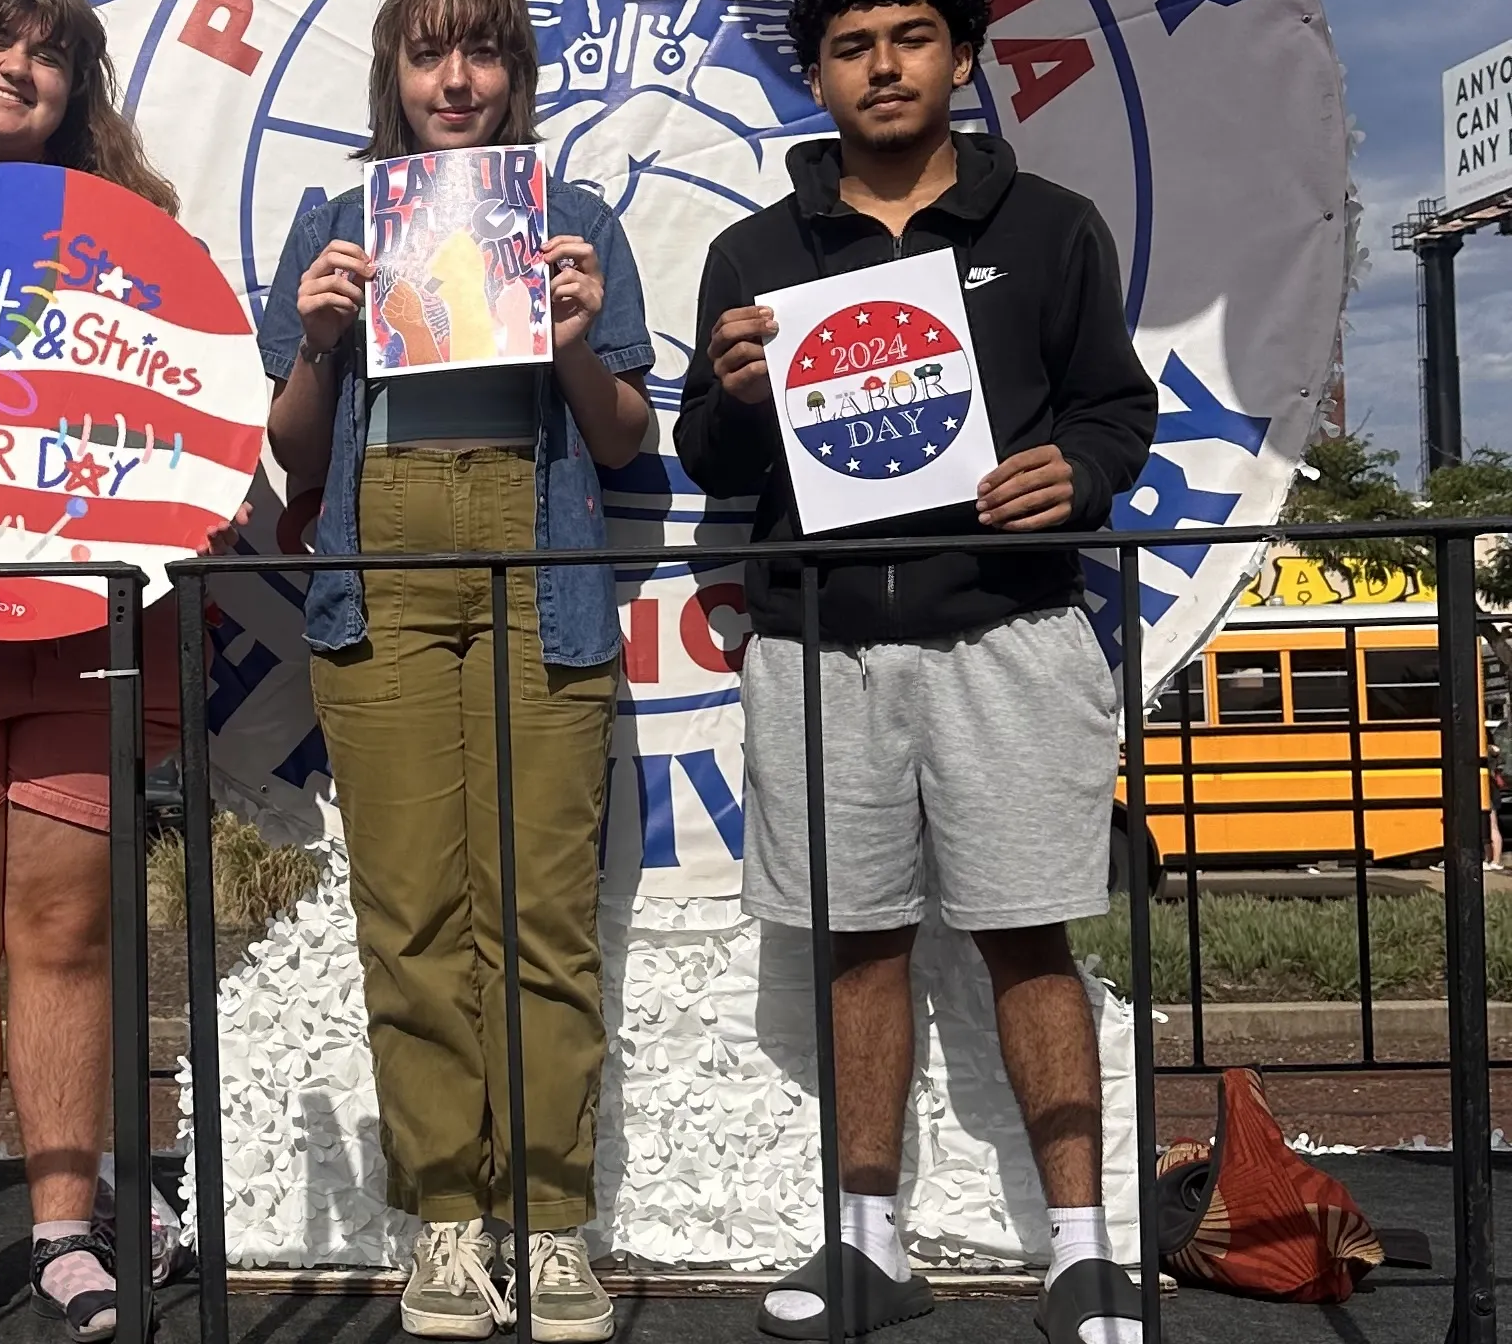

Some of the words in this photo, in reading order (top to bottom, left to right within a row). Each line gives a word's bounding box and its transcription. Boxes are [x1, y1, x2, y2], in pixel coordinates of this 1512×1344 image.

[1456, 98, 1499, 140] CAN
[1457, 133, 1500, 177] ANY
[372, 150, 538, 212] LAOR
[968, 267, 998, 280] NIKE
[70, 312, 203, 396] Stripes
[830, 333, 908, 375] 2024
[815, 370, 948, 424] LABOR
[844, 407, 925, 449] DAY
